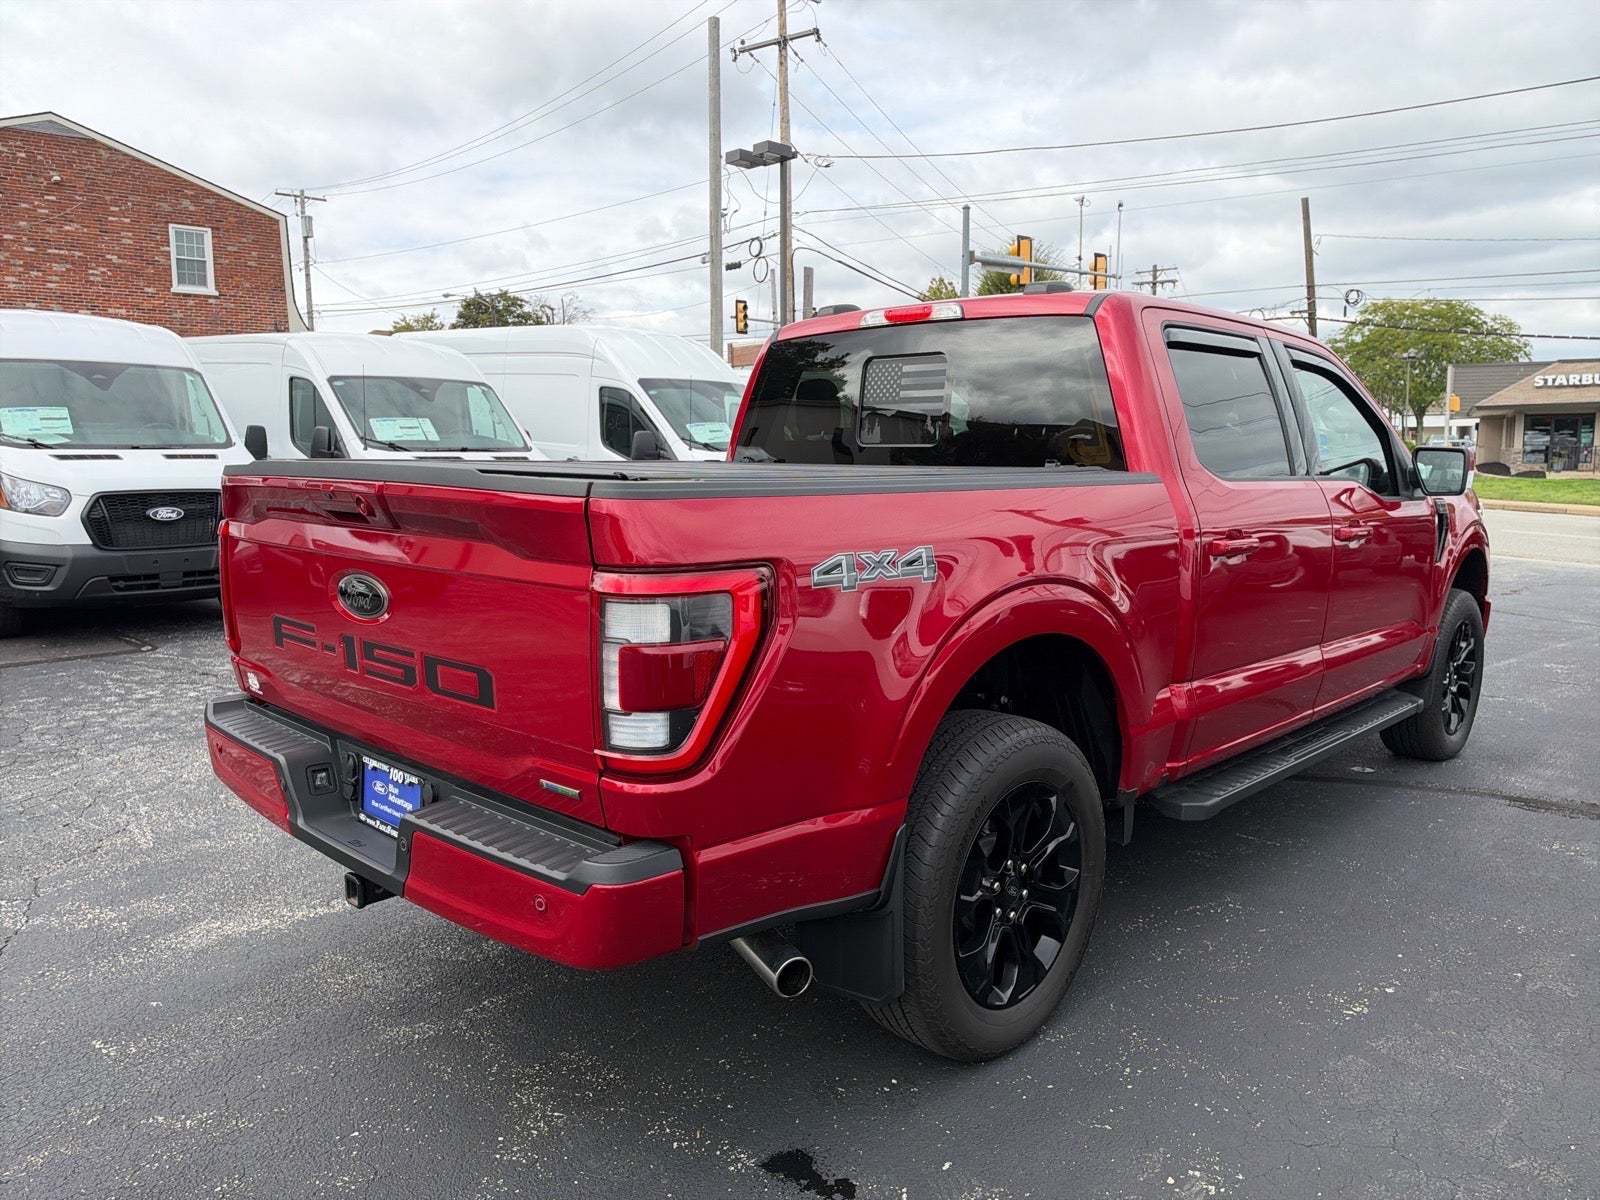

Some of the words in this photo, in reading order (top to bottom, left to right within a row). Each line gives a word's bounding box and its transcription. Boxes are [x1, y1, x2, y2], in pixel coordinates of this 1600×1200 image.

[156, 509, 178, 518] Ford
[345, 580, 373, 610] Ford
[272, 614, 496, 710] F-150
[389, 767, 404, 784] 100
[388, 783, 400, 796] Blue
[388, 793, 413, 811] Advantage
